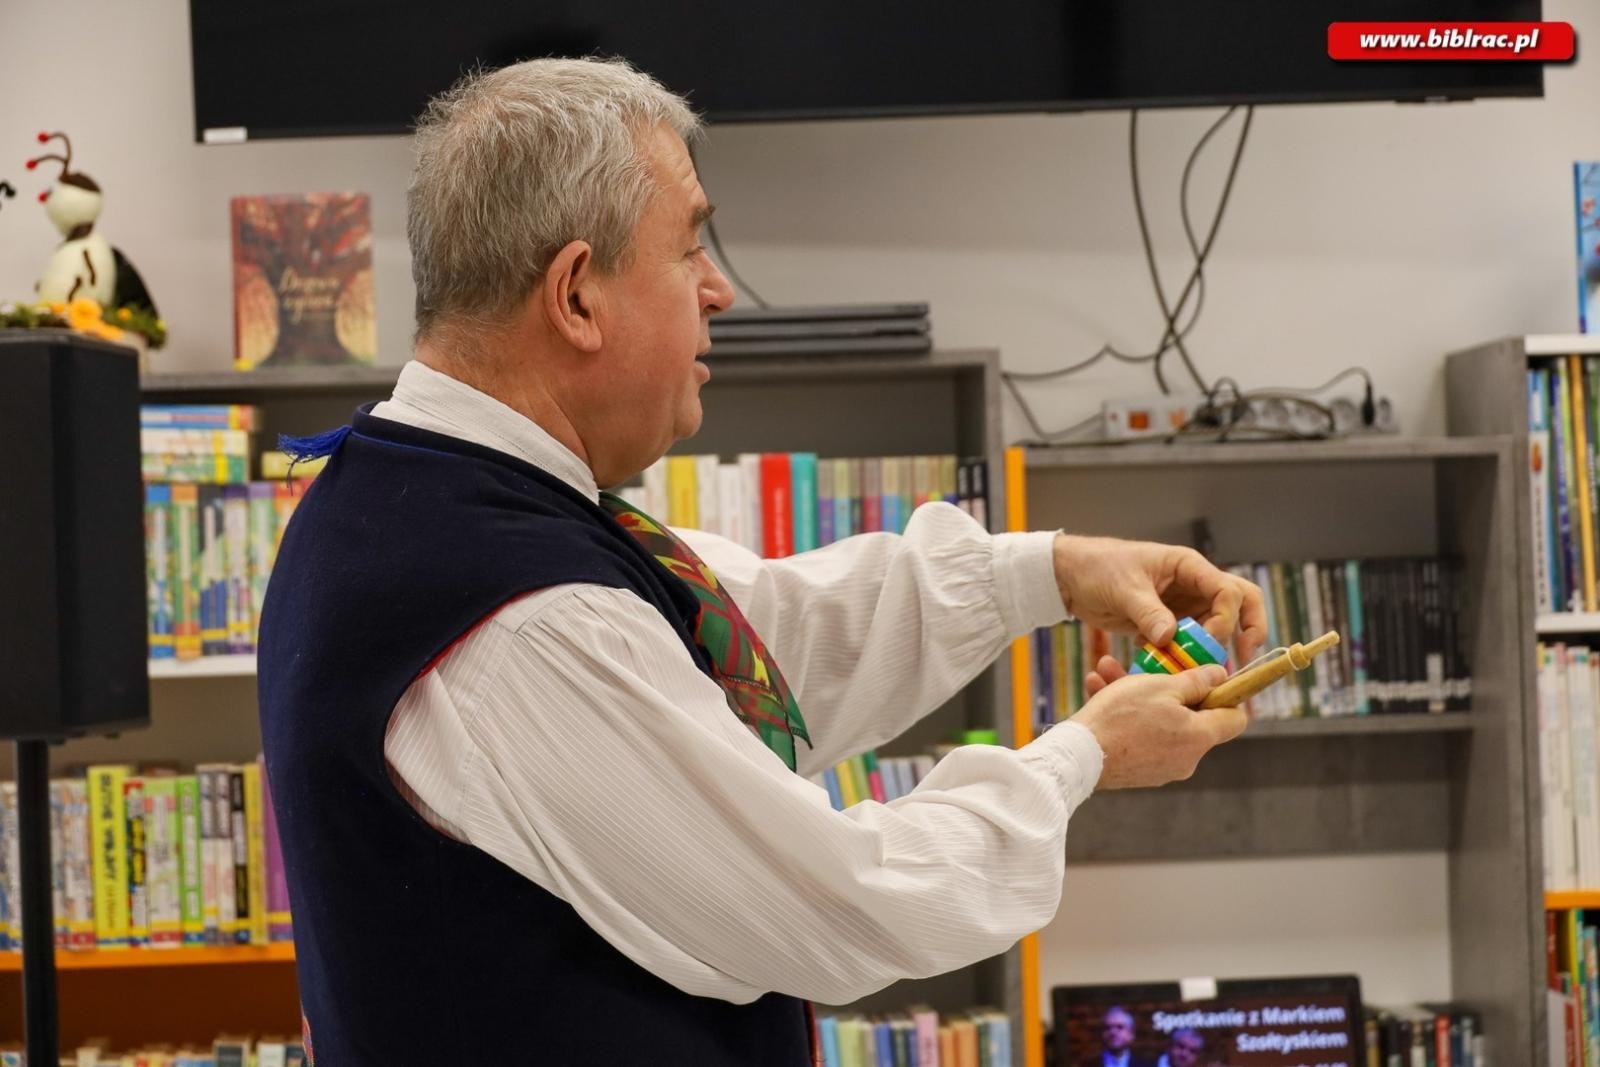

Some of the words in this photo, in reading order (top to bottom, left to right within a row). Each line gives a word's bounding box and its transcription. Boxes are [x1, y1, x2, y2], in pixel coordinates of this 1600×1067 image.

[1152, 1009, 1245, 1033] Spotkanie
[1248, 1011, 1259, 1026] z
[1262, 1005, 1345, 1025] Markiem
